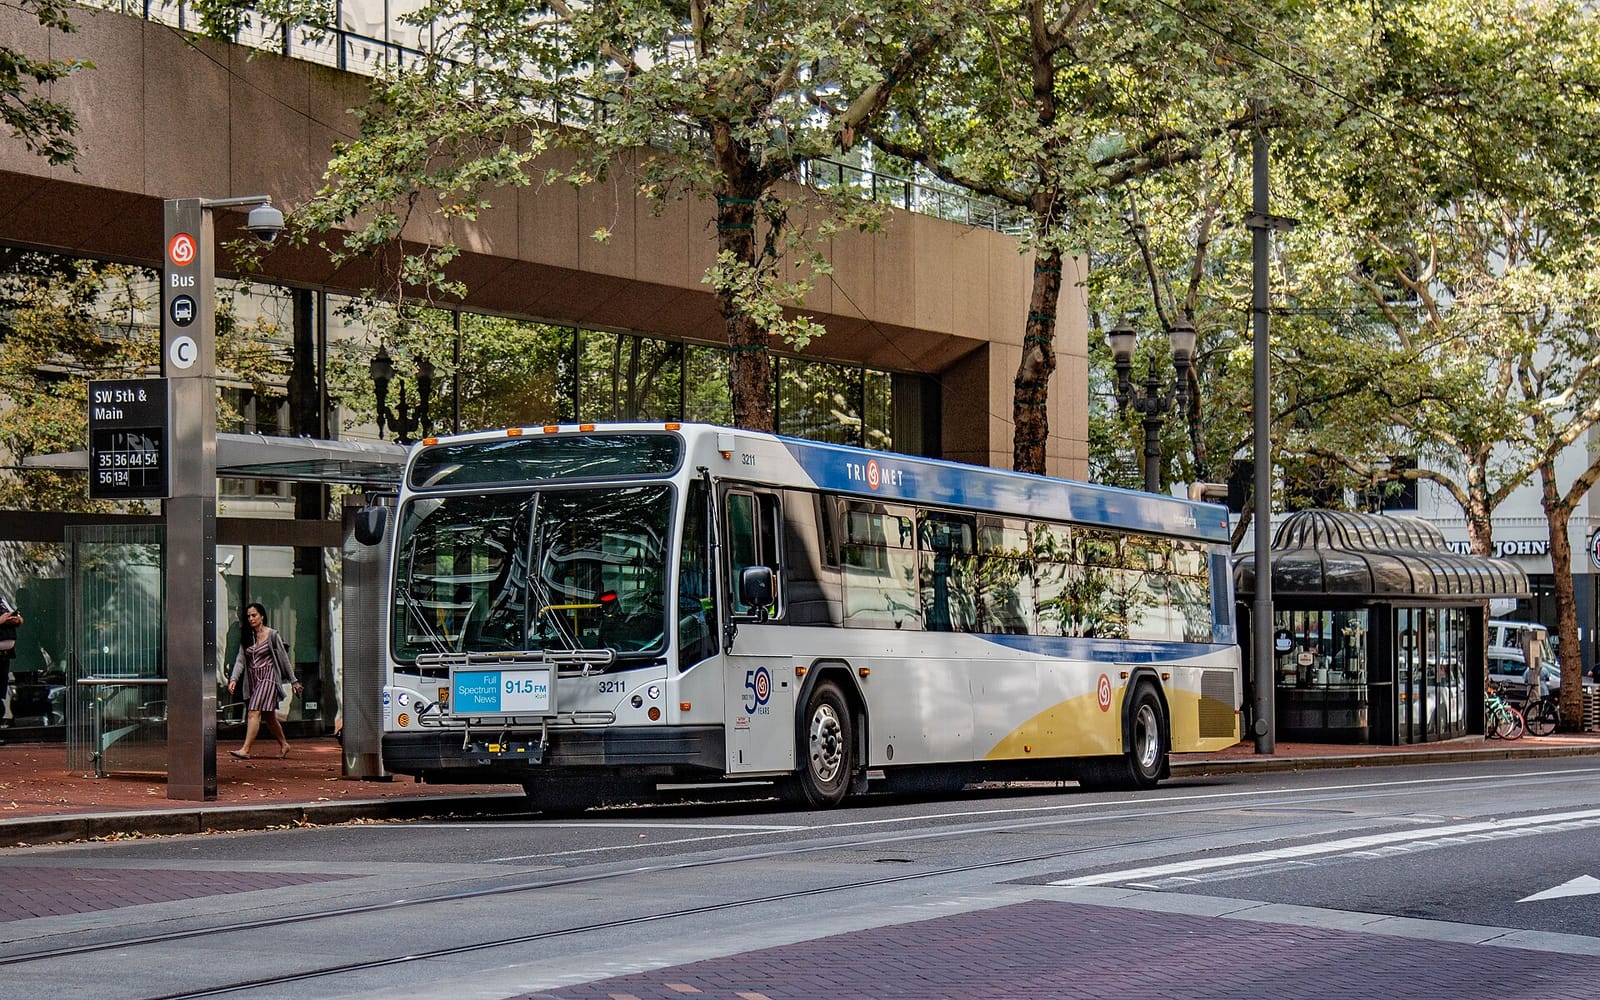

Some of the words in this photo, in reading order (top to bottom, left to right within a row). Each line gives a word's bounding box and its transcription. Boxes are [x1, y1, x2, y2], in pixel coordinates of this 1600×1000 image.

[171, 273, 195, 287] Bus
[177, 342, 189, 362] C
[95, 390, 113, 403] SW
[115, 389, 135, 403] 5th
[138, 389, 147, 402] &
[95, 407, 123, 420] Main
[99, 454, 112, 467] 35
[114, 454, 127, 466] 36
[129, 454, 142, 466] 44
[145, 453, 157, 465] 54
[741, 453, 756, 466] 3211
[99, 472, 112, 484] 56
[114, 471, 128, 482] 134
[846, 463, 866, 481] TRI
[881, 469, 903, 486] MET
[483, 675, 497, 684] Full
[458, 685, 497, 696] Spectrum
[505, 680, 533, 694] 91.5
[534, 685, 547, 693] FM
[598, 681, 626, 693] 3211
[474, 695, 497, 704] News
